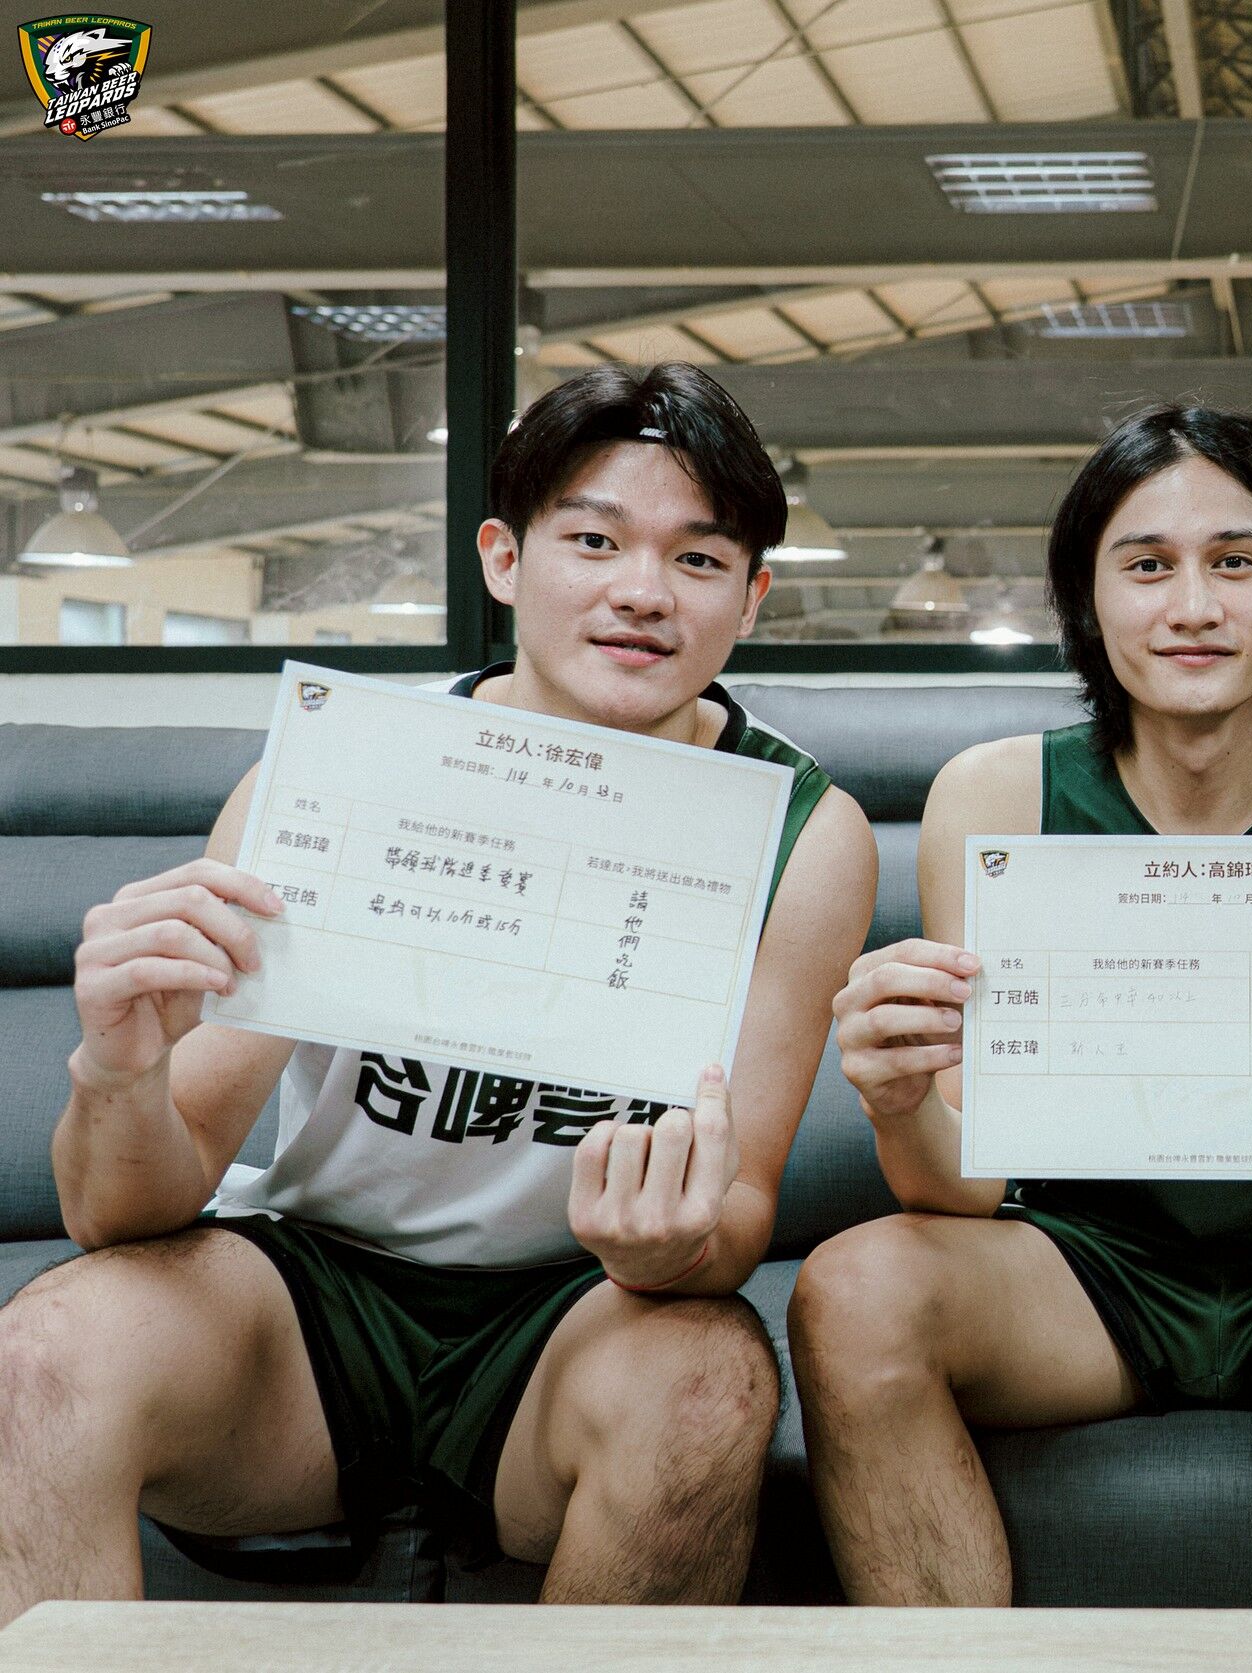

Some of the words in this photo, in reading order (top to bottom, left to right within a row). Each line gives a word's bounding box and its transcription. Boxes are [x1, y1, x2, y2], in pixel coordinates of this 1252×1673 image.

[475, 730, 604, 771] 立約人：徐宏偉
[505, 767, 529, 788] 114
[542, 776, 554, 790] 年
[560, 777, 575, 792] 10
[578, 784, 589, 797] 月
[612, 790, 624, 803] 日
[294, 797, 322, 814] 姓名
[276, 829, 330, 852] 高錦瑋
[398, 817, 516, 852] 我給他的新賽季任務
[1001, 958, 1024, 970] 姓名
[1092, 958, 1200, 971] 我給他的新賽季任務
[991, 989, 1039, 1005] 丁冠皓
[990, 1039, 1039, 1055] 徐宏瑋
